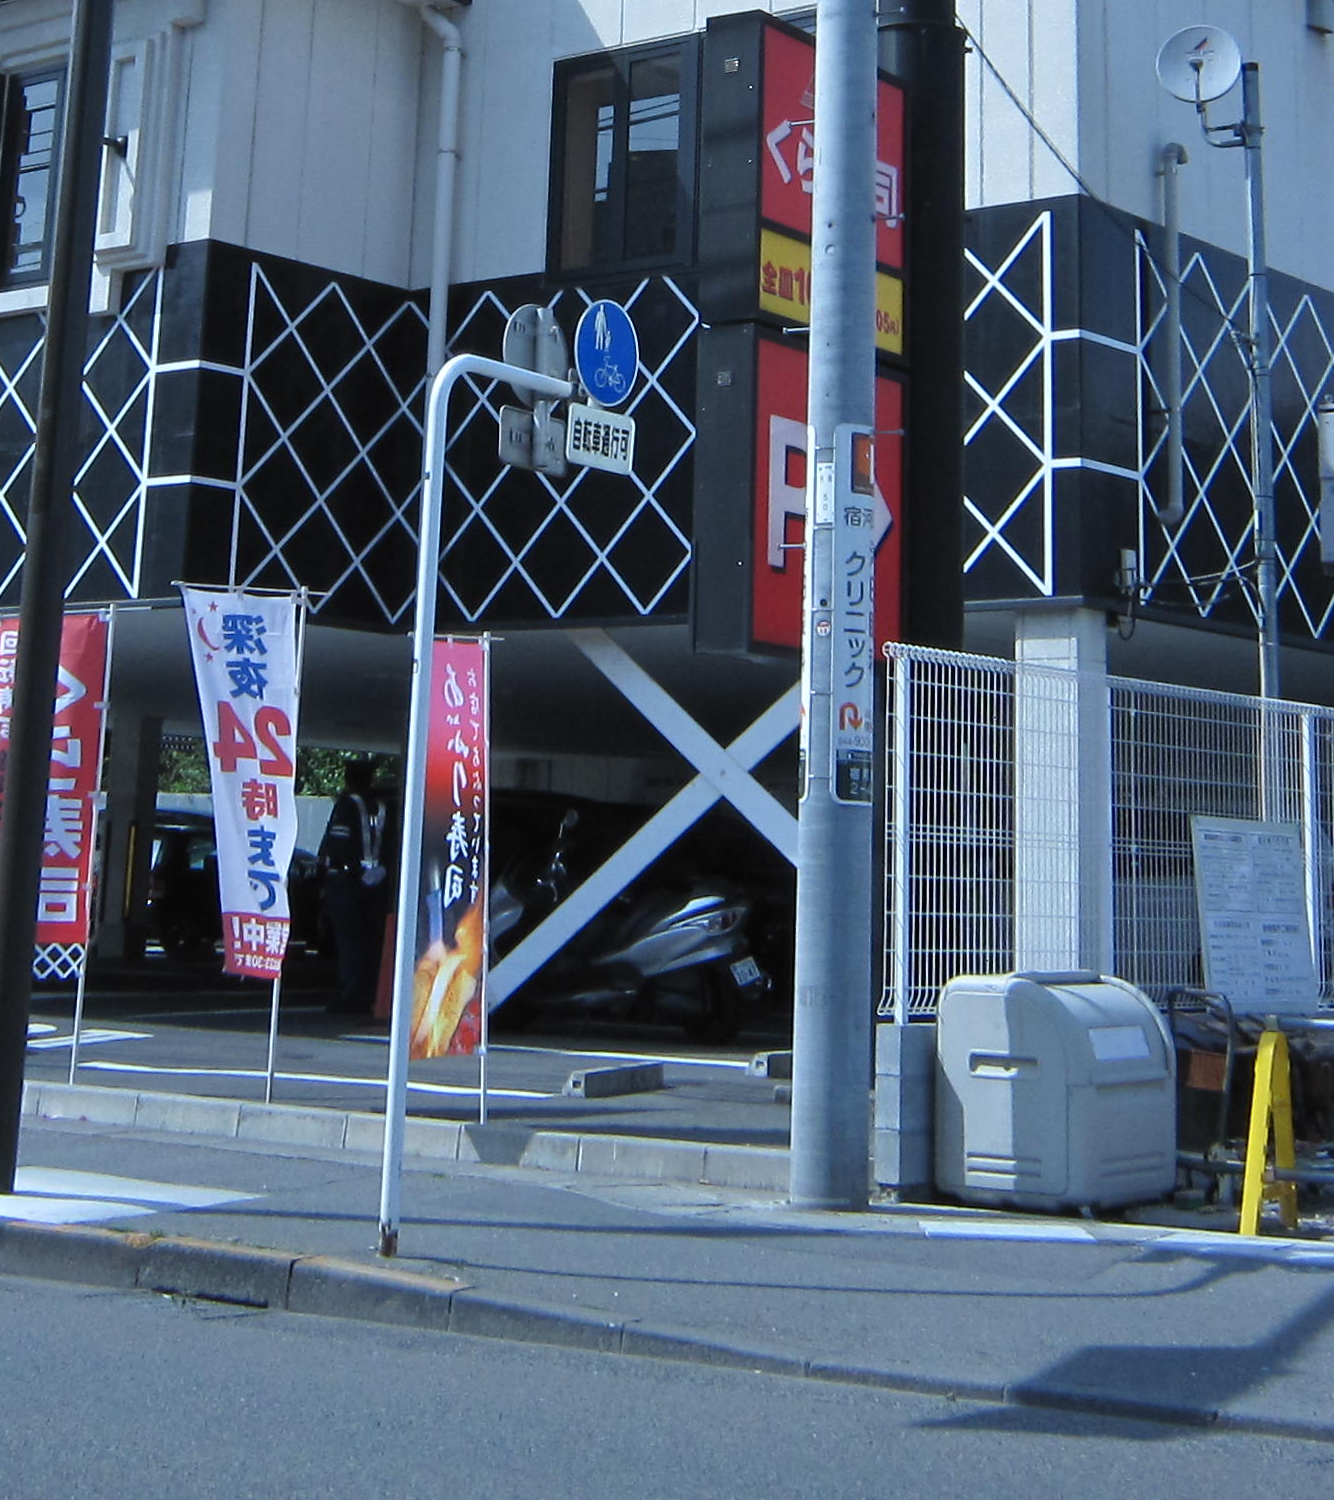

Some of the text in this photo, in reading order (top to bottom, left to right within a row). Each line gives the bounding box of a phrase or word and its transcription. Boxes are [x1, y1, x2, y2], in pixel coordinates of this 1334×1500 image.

[842, 551, 866, 688] クリニック
